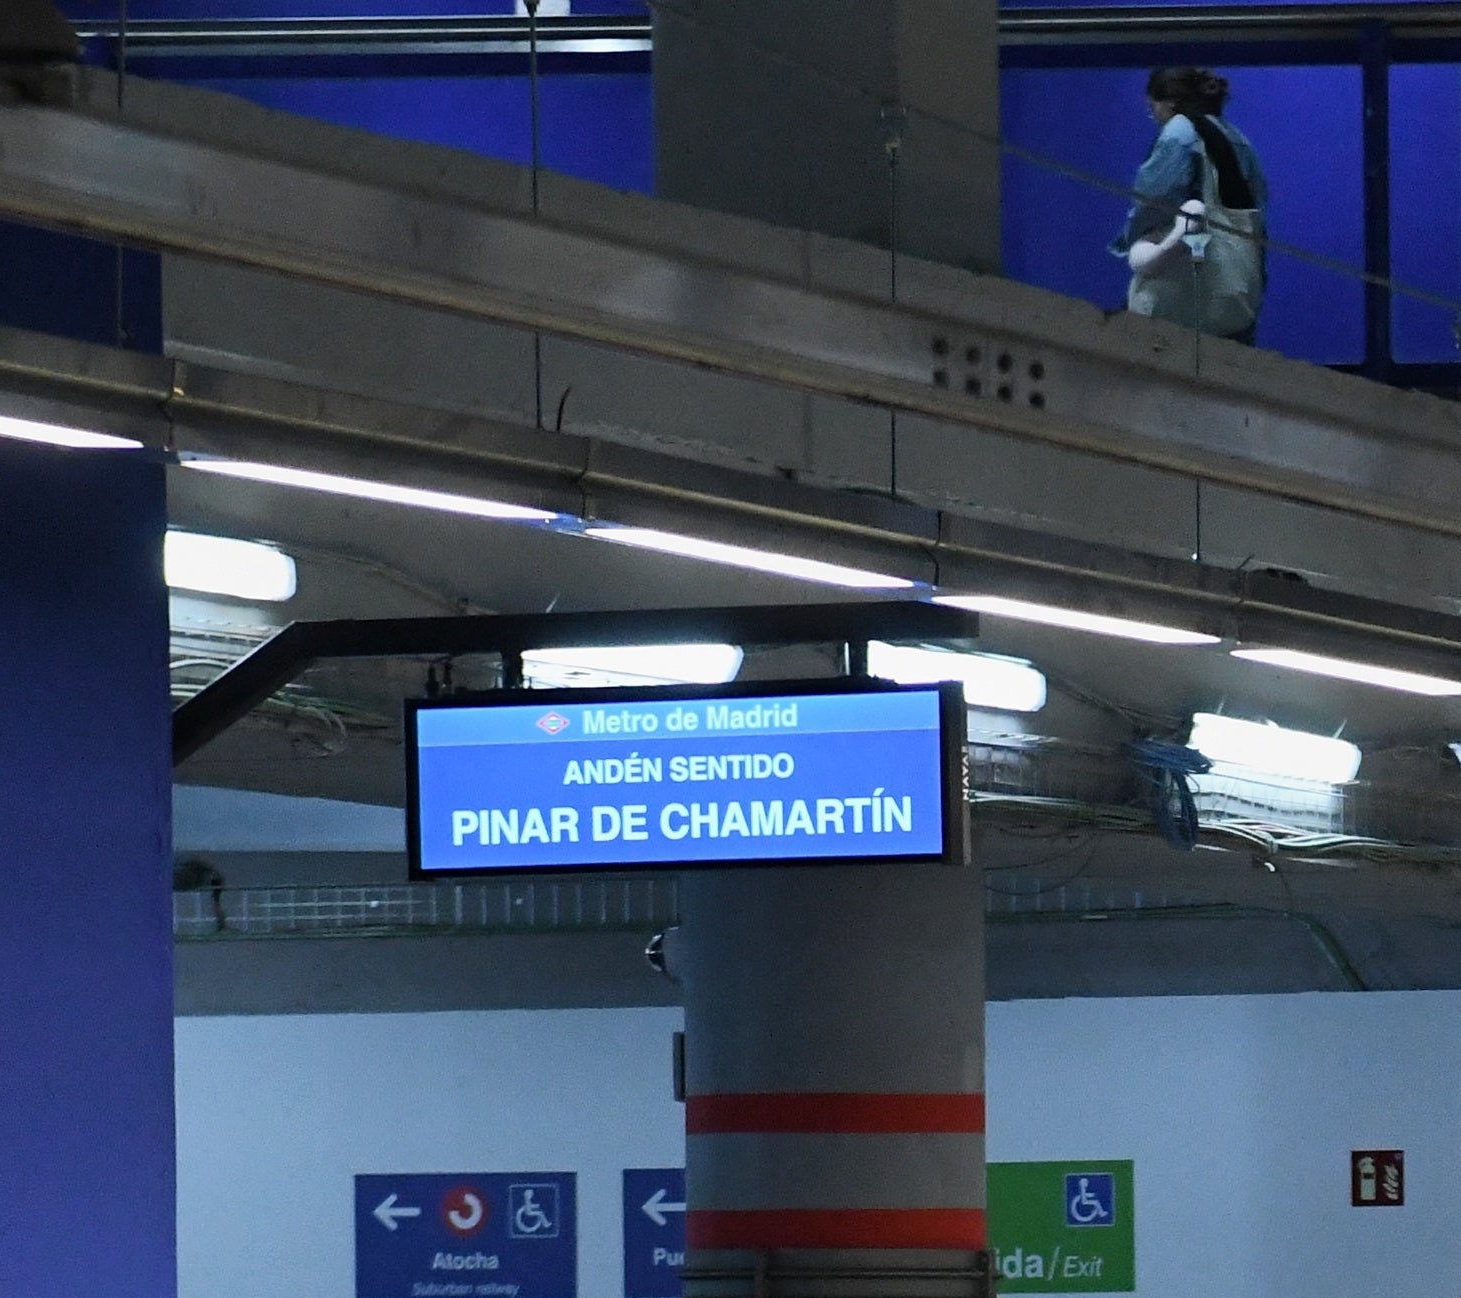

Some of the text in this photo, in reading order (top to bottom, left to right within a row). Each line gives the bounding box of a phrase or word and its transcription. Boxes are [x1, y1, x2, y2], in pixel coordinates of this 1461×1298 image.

[582, 703, 798, 735] Metro de Madrid
[562, 752, 794, 785] ANDÉN SENTIDO
[452, 787, 912, 846] PINAR DE CHAMARTÍN
[432, 1251, 500, 1270] Atocha
